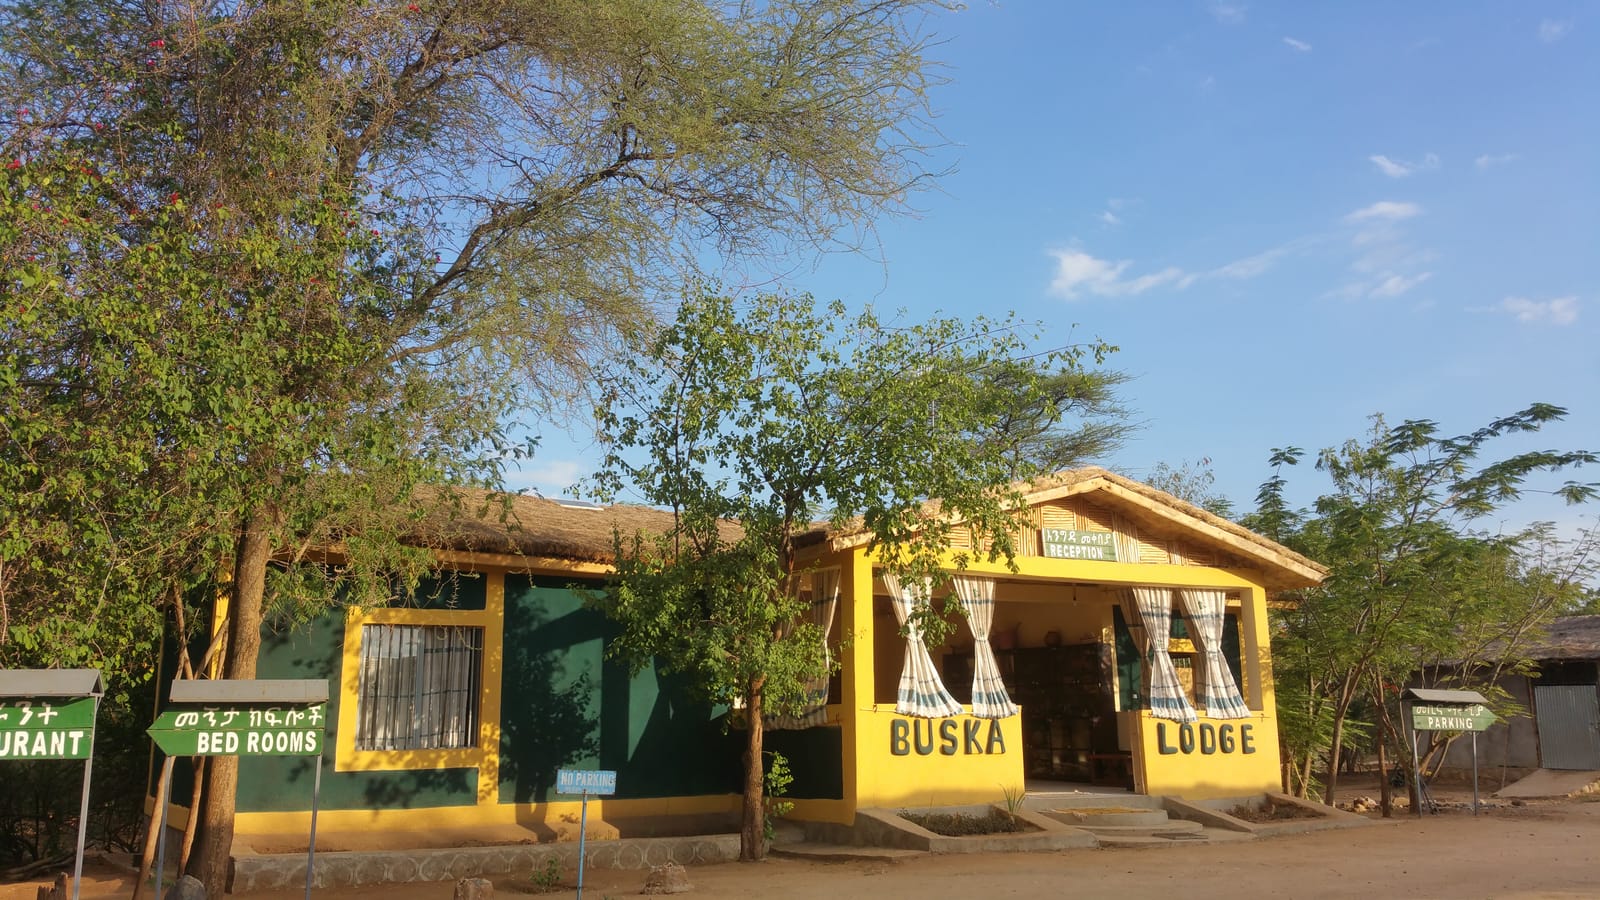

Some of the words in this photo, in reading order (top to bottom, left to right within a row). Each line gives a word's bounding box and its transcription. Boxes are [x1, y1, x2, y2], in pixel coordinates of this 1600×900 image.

[1050, 544, 1103, 559] RECEPTION
[174, 705, 240, 728] መኝታ
[249, 703, 323, 728] ክፍሎች
[1428, 716, 1473, 729] PARKING
[197, 731, 239, 753] BED
[247, 730, 317, 752] ROOMS
[890, 718, 1006, 756] BUSKA
[1156, 721, 1257, 756] LODGE
[561, 772, 573, 785] NO
[576, 773, 616, 786] PARKING
